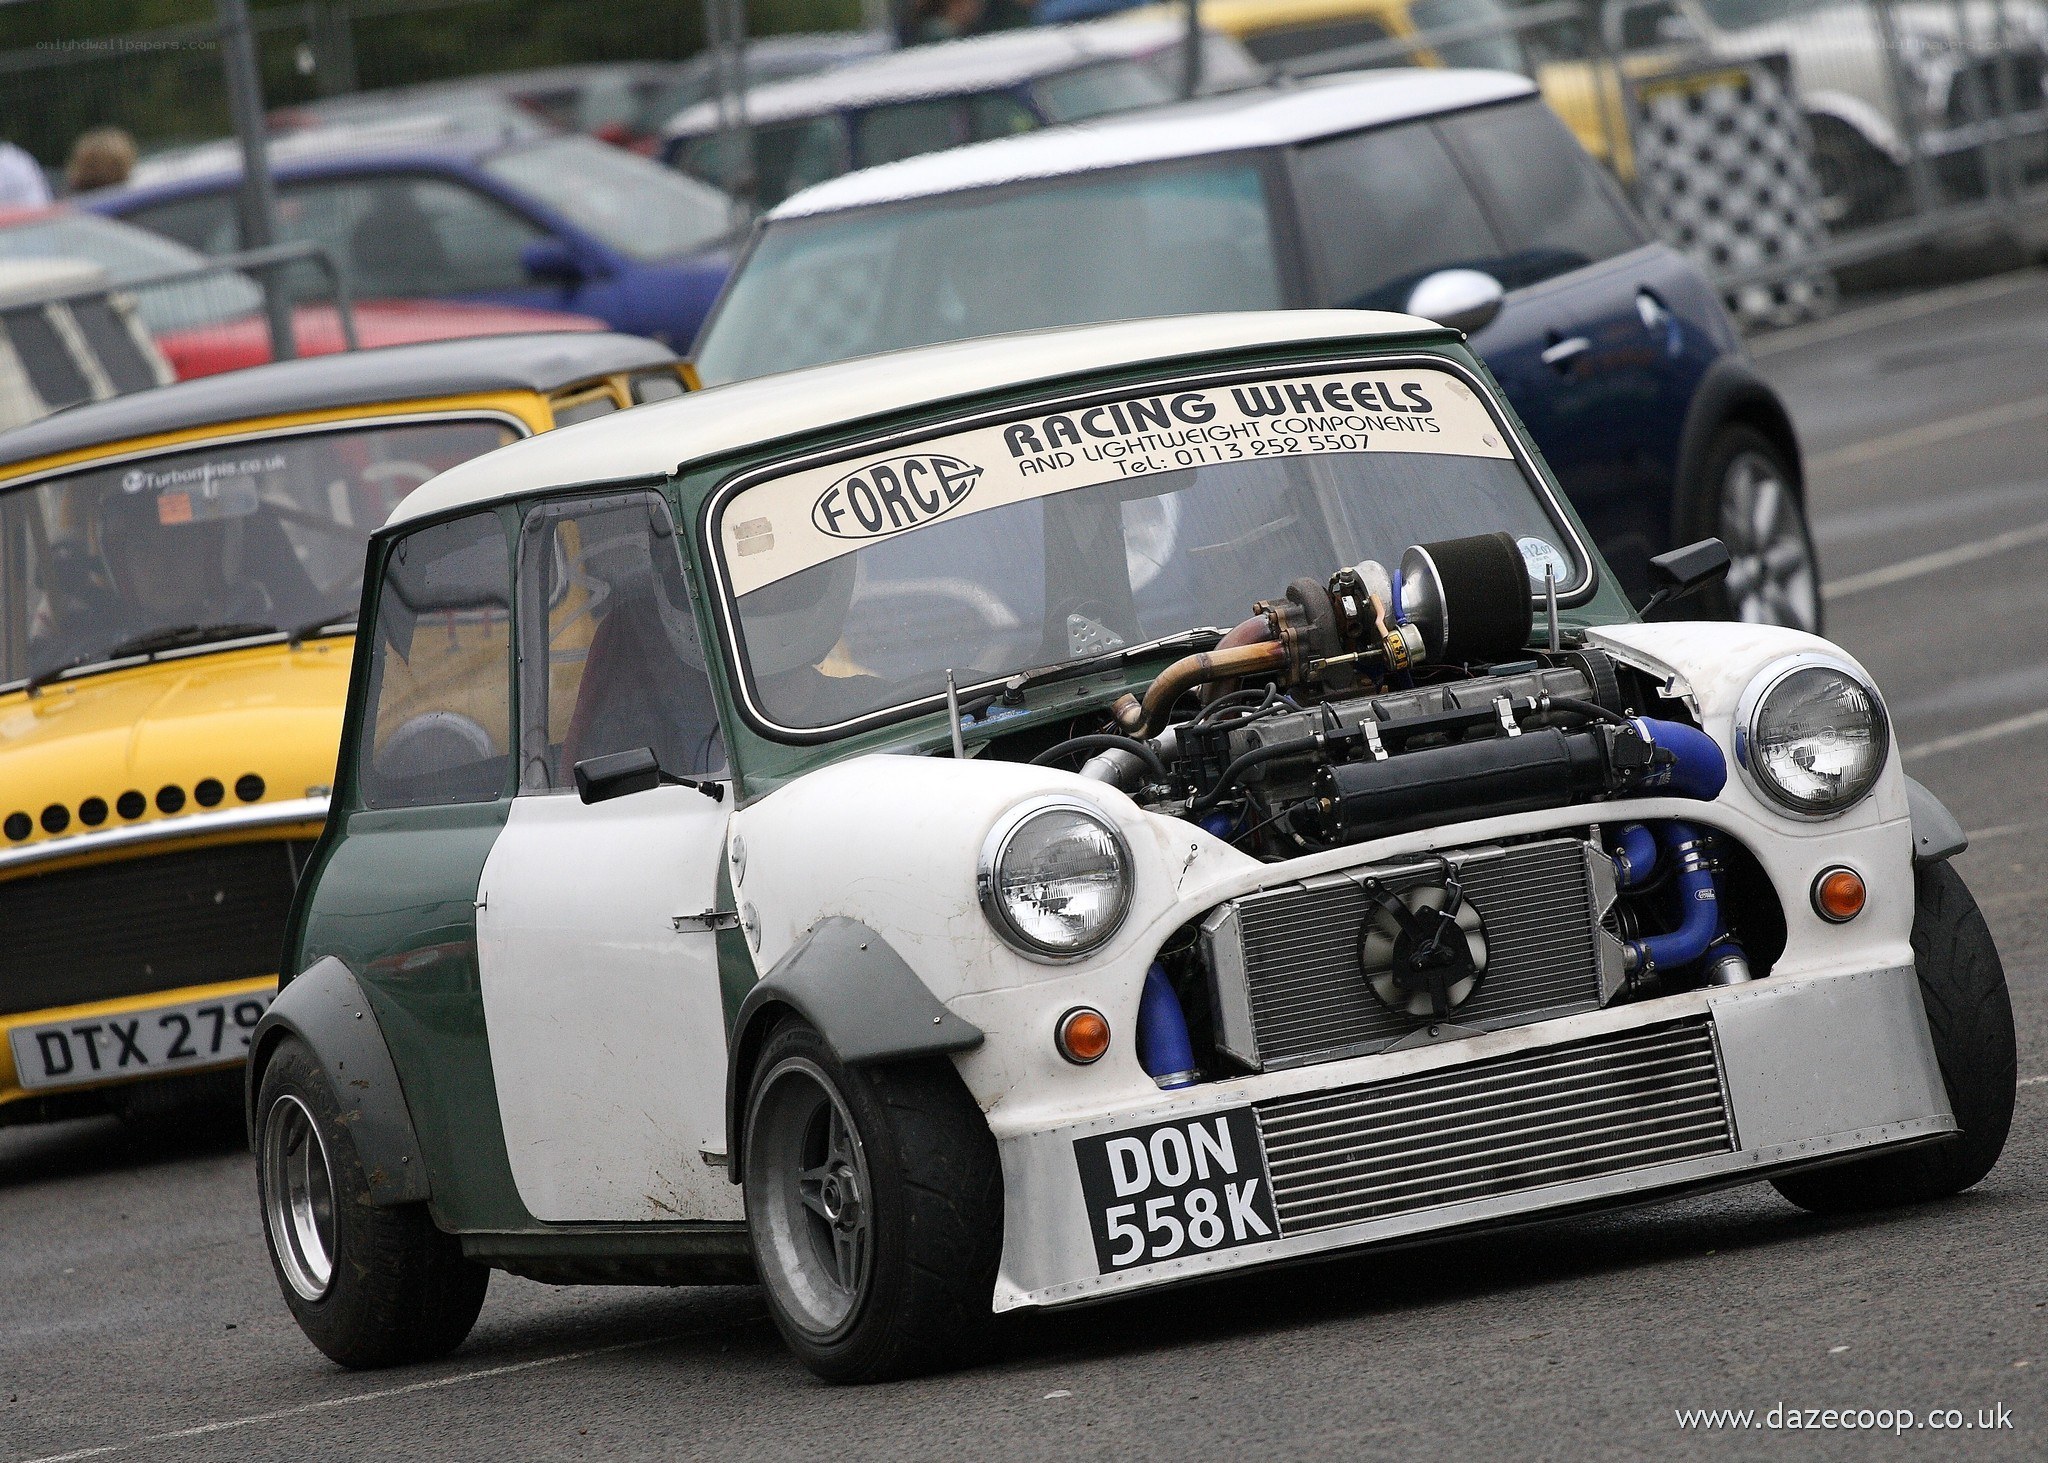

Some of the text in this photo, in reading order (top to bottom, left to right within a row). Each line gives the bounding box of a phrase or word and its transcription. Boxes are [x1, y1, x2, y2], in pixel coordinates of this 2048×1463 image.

[1004, 381, 1433, 458] RACING WHEELS
[1018, 415, 1441, 476] AND LIGHTWEIGHT COMPONENTS
[1174, 442, 1244, 466] 0113
[1250, 437, 1303, 456] 252
[1307, 433, 1369, 451] 5507
[820, 458, 985, 534] FORCE
[36, 997, 276, 1077] DTX 279
[1105, 1116, 1238, 1198] DON
[1105, 1177, 1273, 1266] 558K
